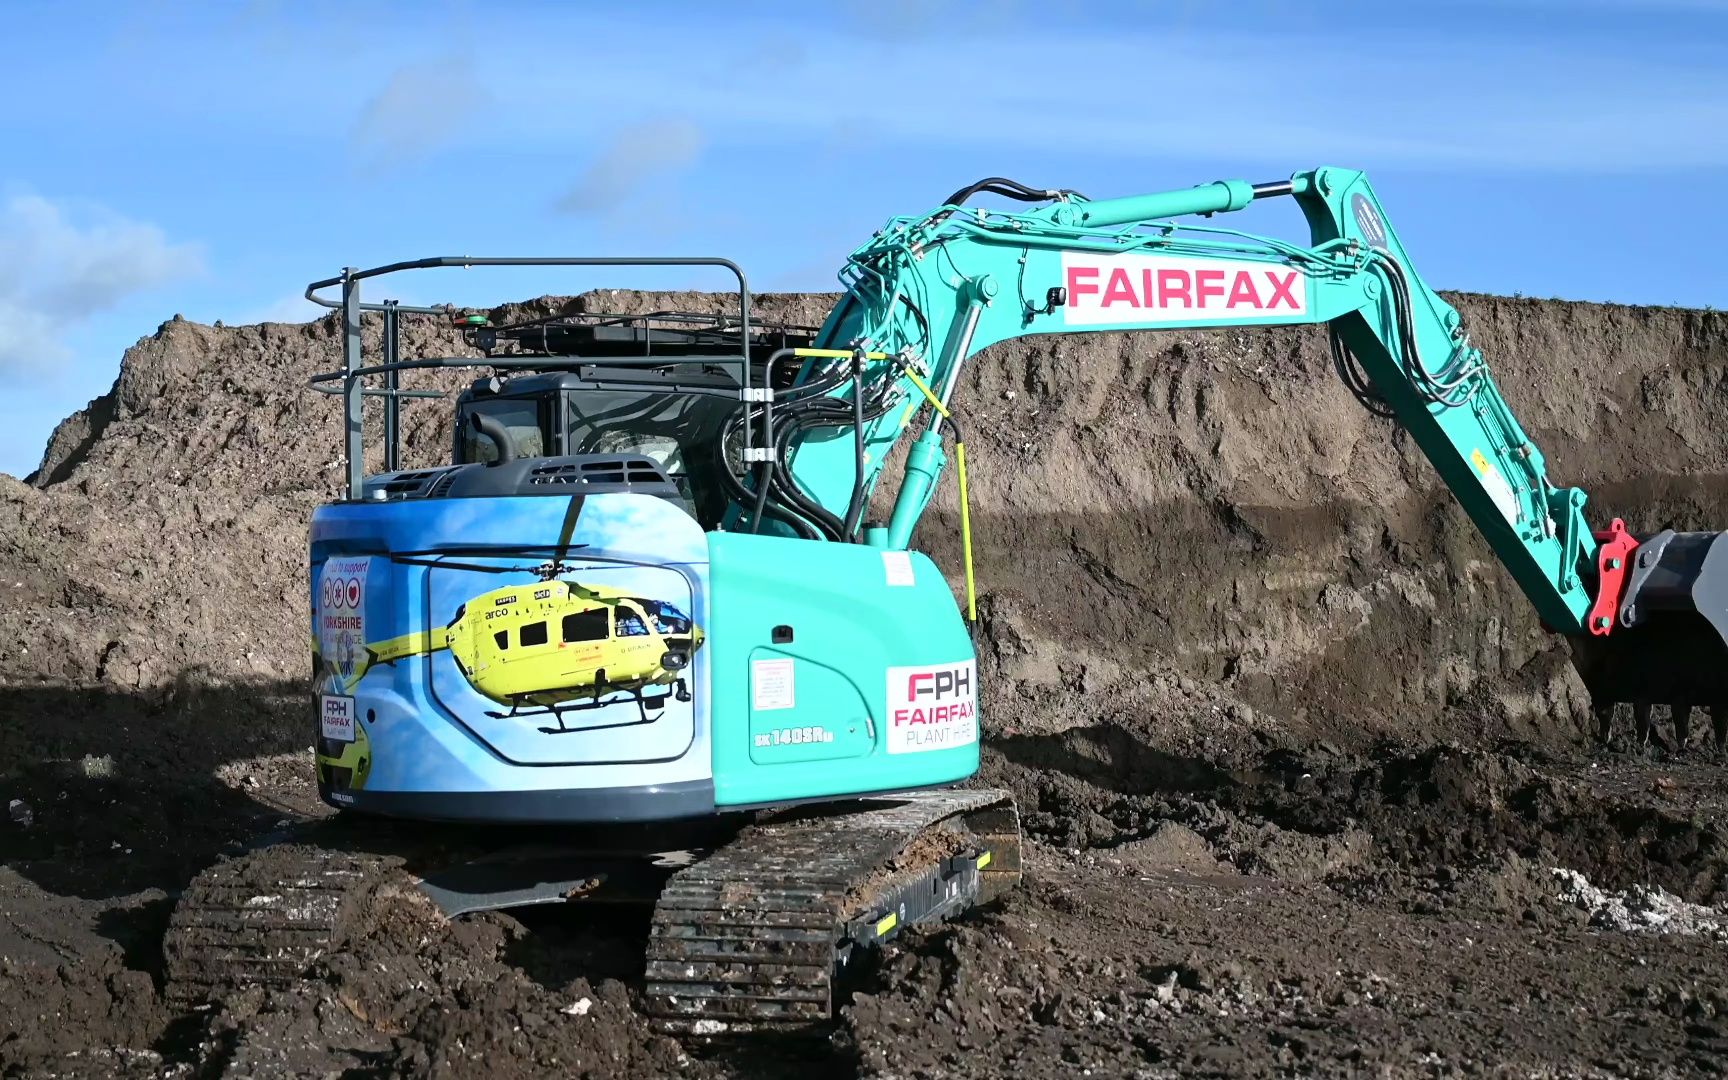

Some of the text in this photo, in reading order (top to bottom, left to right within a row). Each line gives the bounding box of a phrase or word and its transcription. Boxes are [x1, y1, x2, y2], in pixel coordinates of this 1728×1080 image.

[1067, 267, 1301, 309] FAIRFAX
[344, 561, 368, 575] support
[485, 608, 508, 620] arco
[908, 667, 970, 702] FPH
[326, 699, 347, 716] FPH
[895, 700, 974, 727] FAIRFAX
[323, 715, 351, 727] FAIRFAX
[906, 728, 950, 745] PLANT
